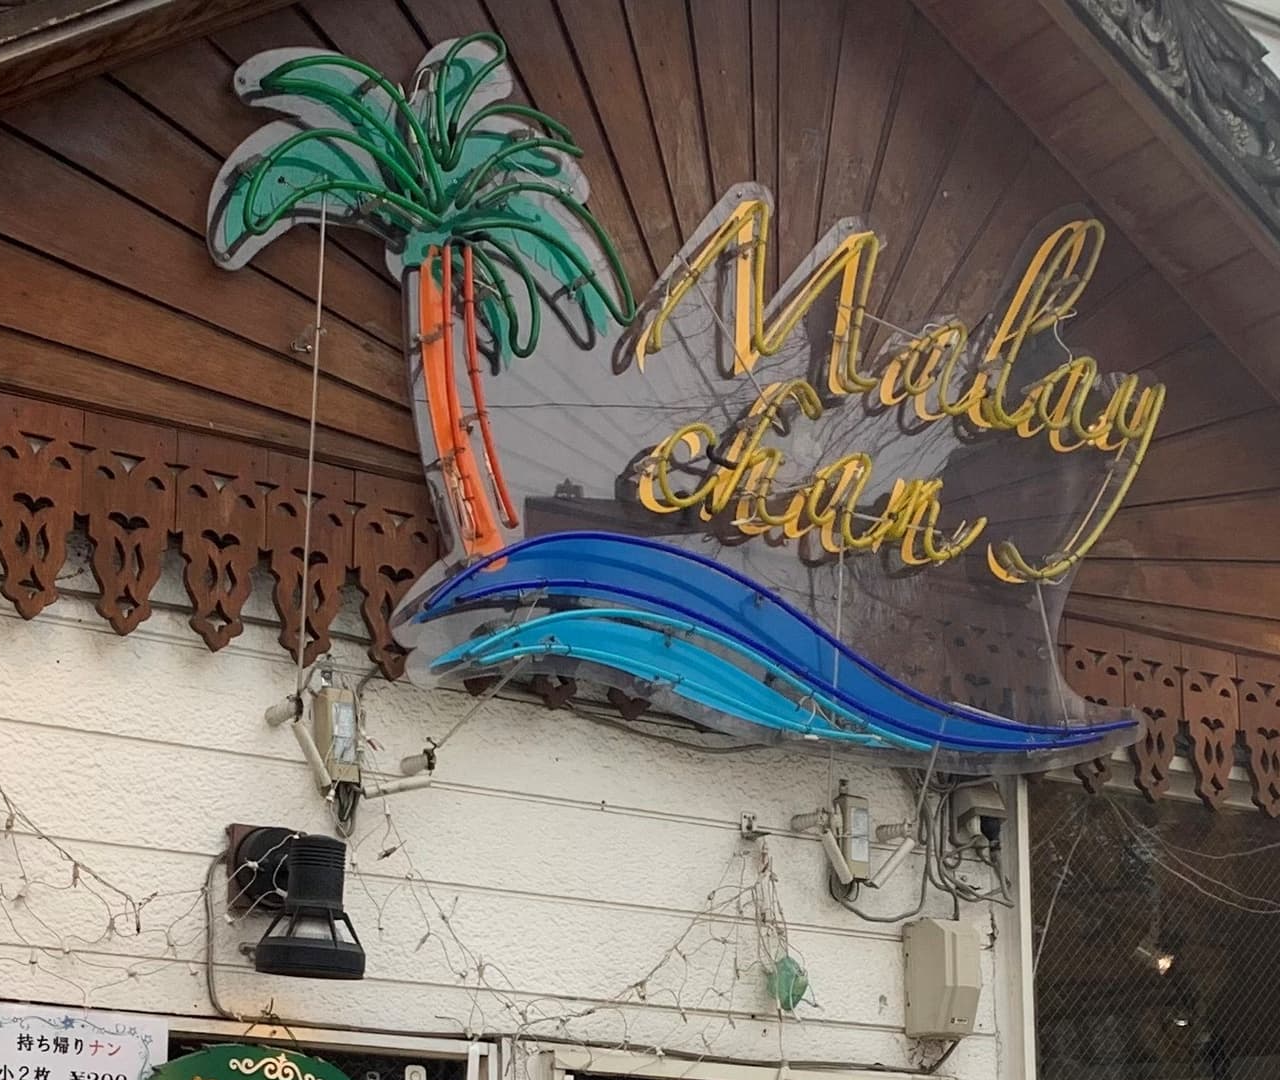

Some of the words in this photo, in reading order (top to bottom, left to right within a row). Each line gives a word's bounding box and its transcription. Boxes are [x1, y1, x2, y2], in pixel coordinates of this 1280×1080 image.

[635, 197, 1166, 584] Malay
[16, 1032, 122, 1057] 持ち帰りナン
